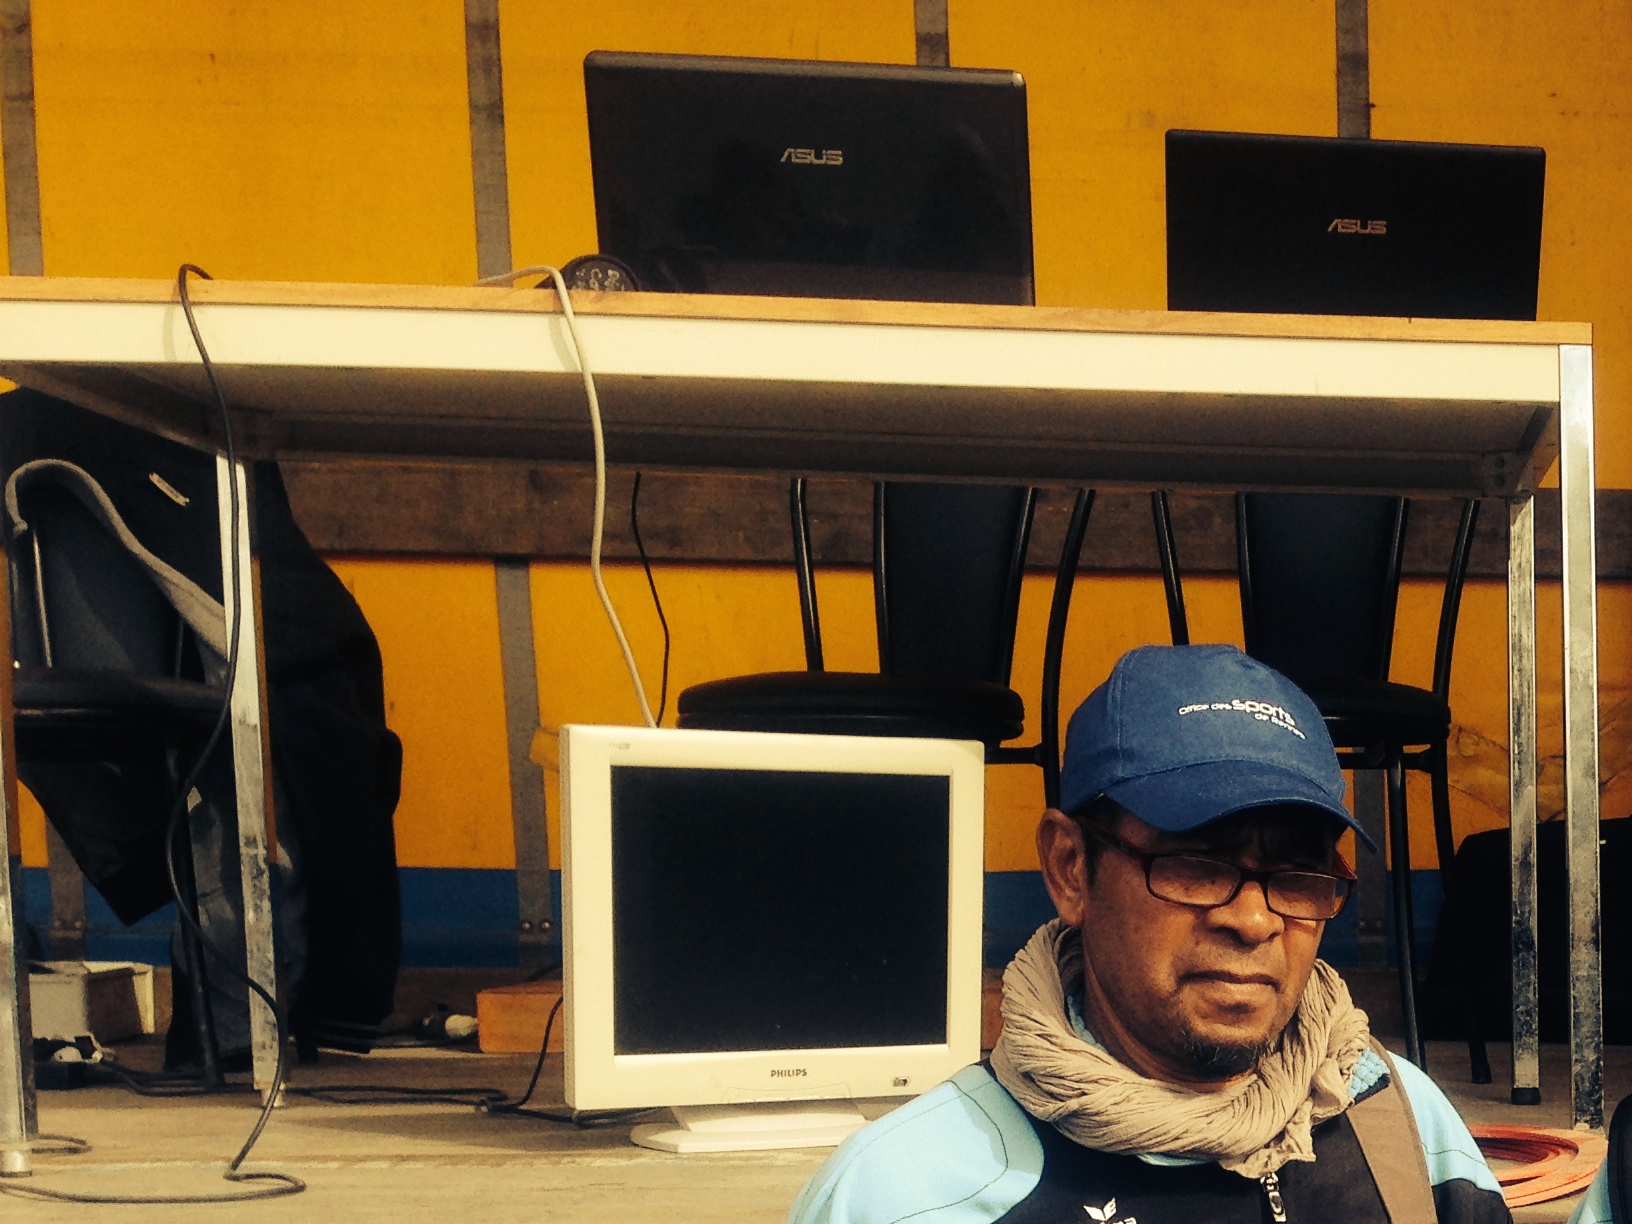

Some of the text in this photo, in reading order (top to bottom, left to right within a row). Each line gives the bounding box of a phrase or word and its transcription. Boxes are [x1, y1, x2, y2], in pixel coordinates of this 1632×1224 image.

[780, 147, 844, 165] ASUS
[1327, 218, 1388, 235] ASUS
[1231, 698, 1296, 727] Sports
[770, 1067, 808, 1078] PHILIPS
